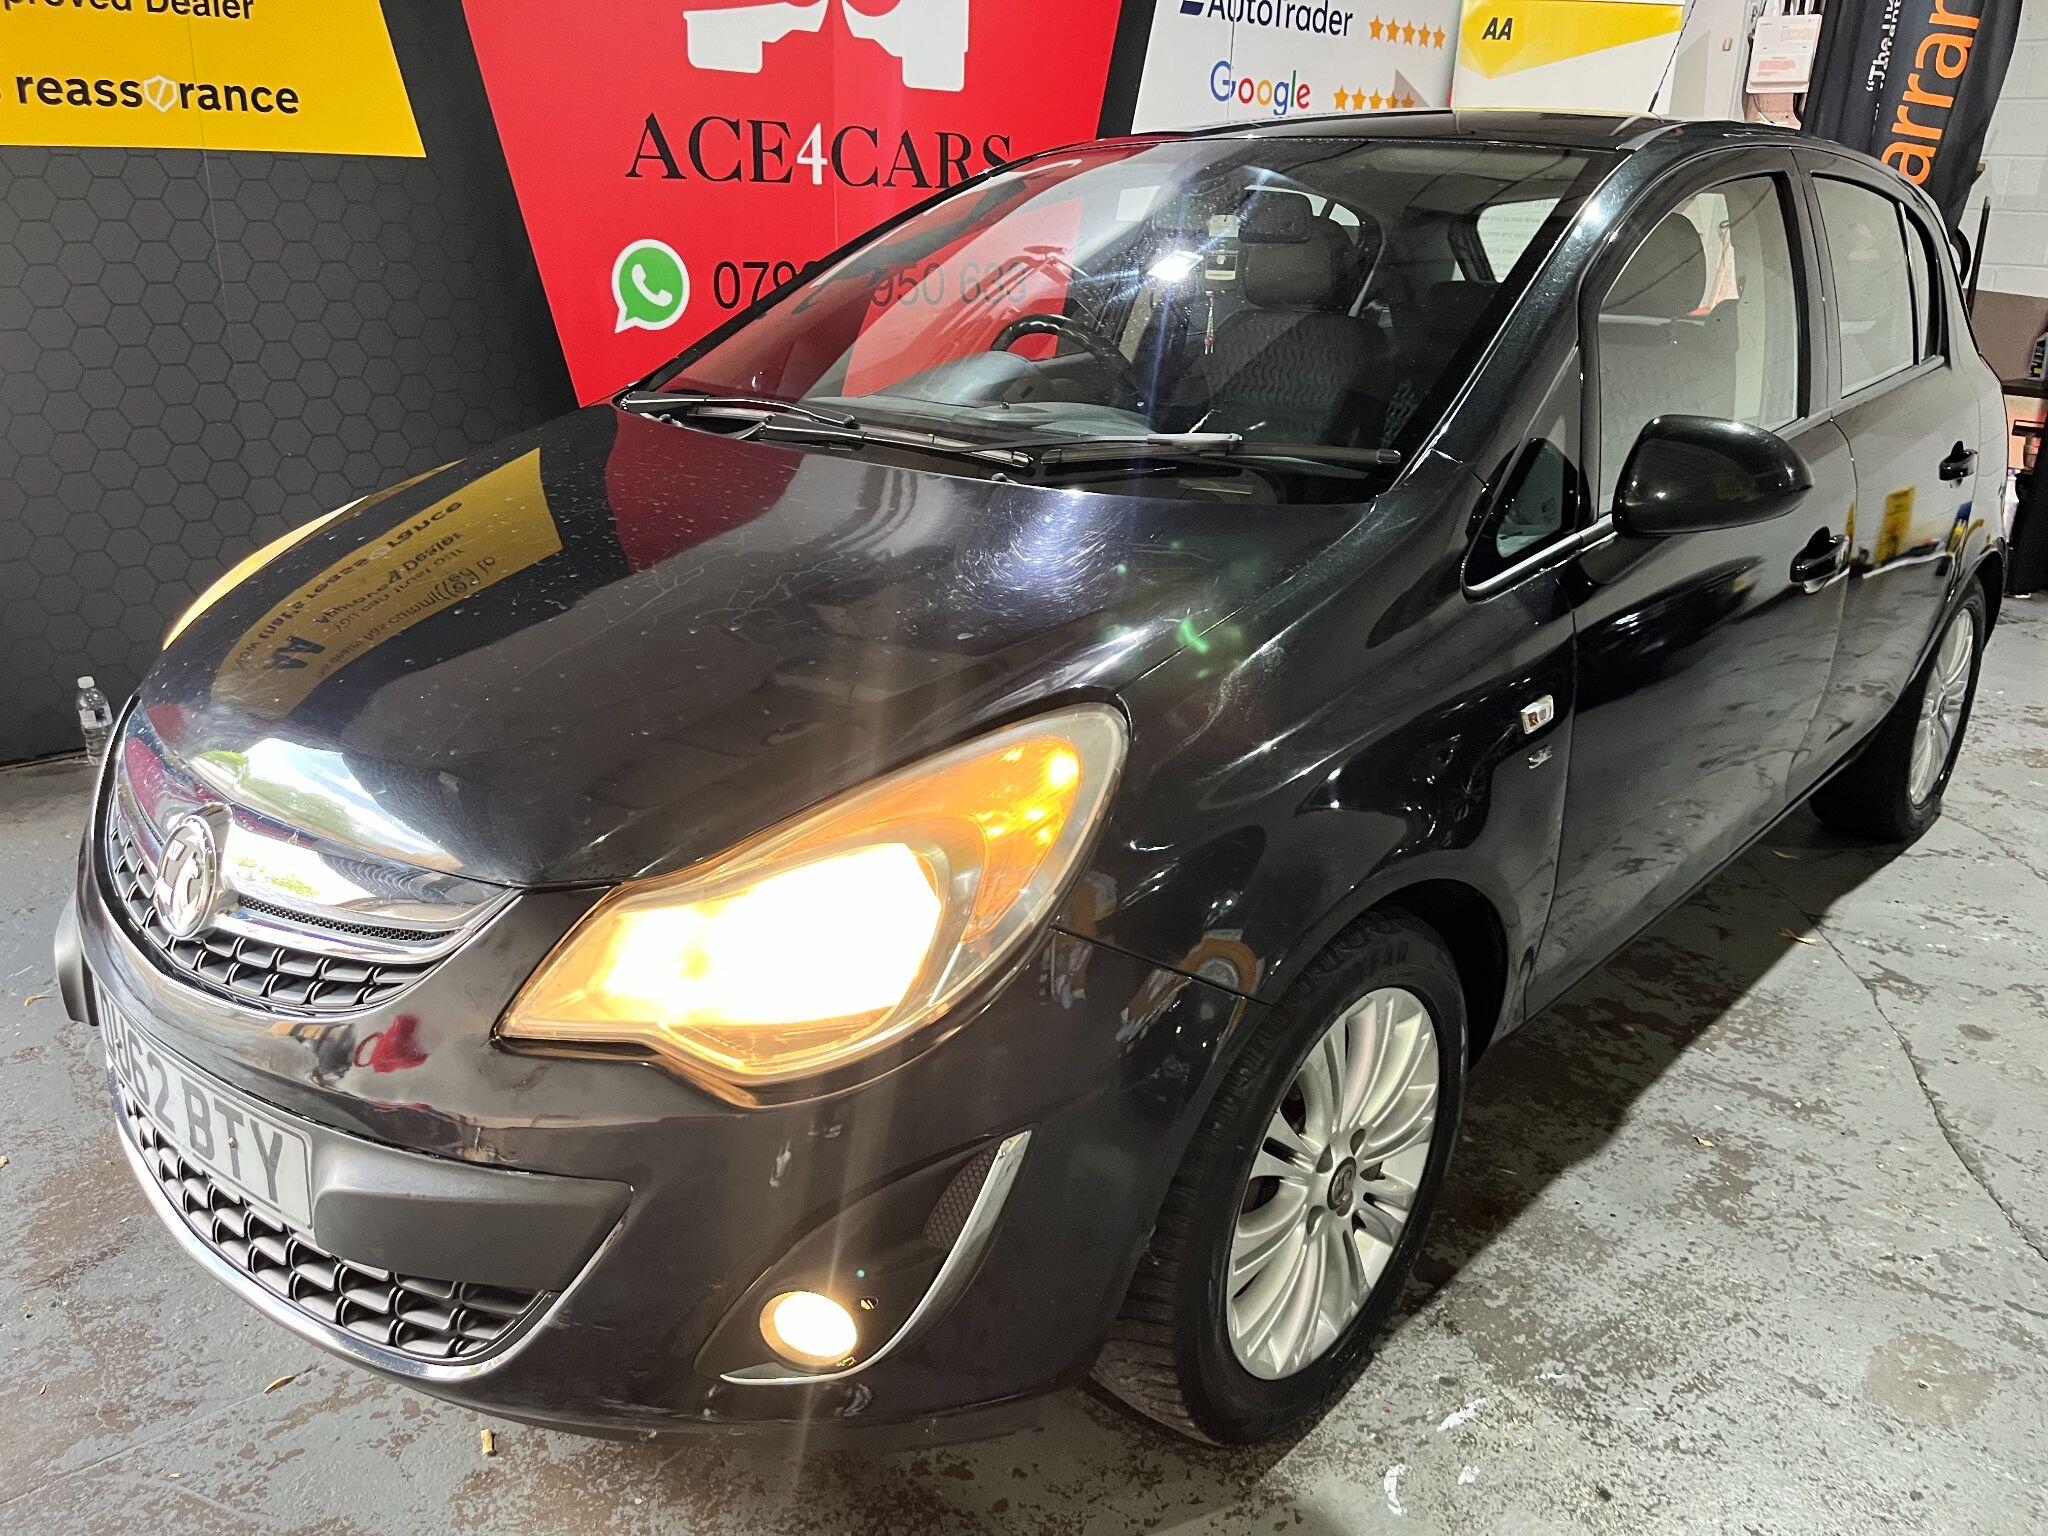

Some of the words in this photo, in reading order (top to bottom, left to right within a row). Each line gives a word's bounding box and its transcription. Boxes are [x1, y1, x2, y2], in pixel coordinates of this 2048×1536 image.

[1207, 0, 1353, 36] AutoTrader
[1481, 17, 1513, 41] AA
[1210, 60, 1311, 116] Google
[625, 112, 1011, 188] ACE4CARS
[181, 1076, 284, 1205] BTY
